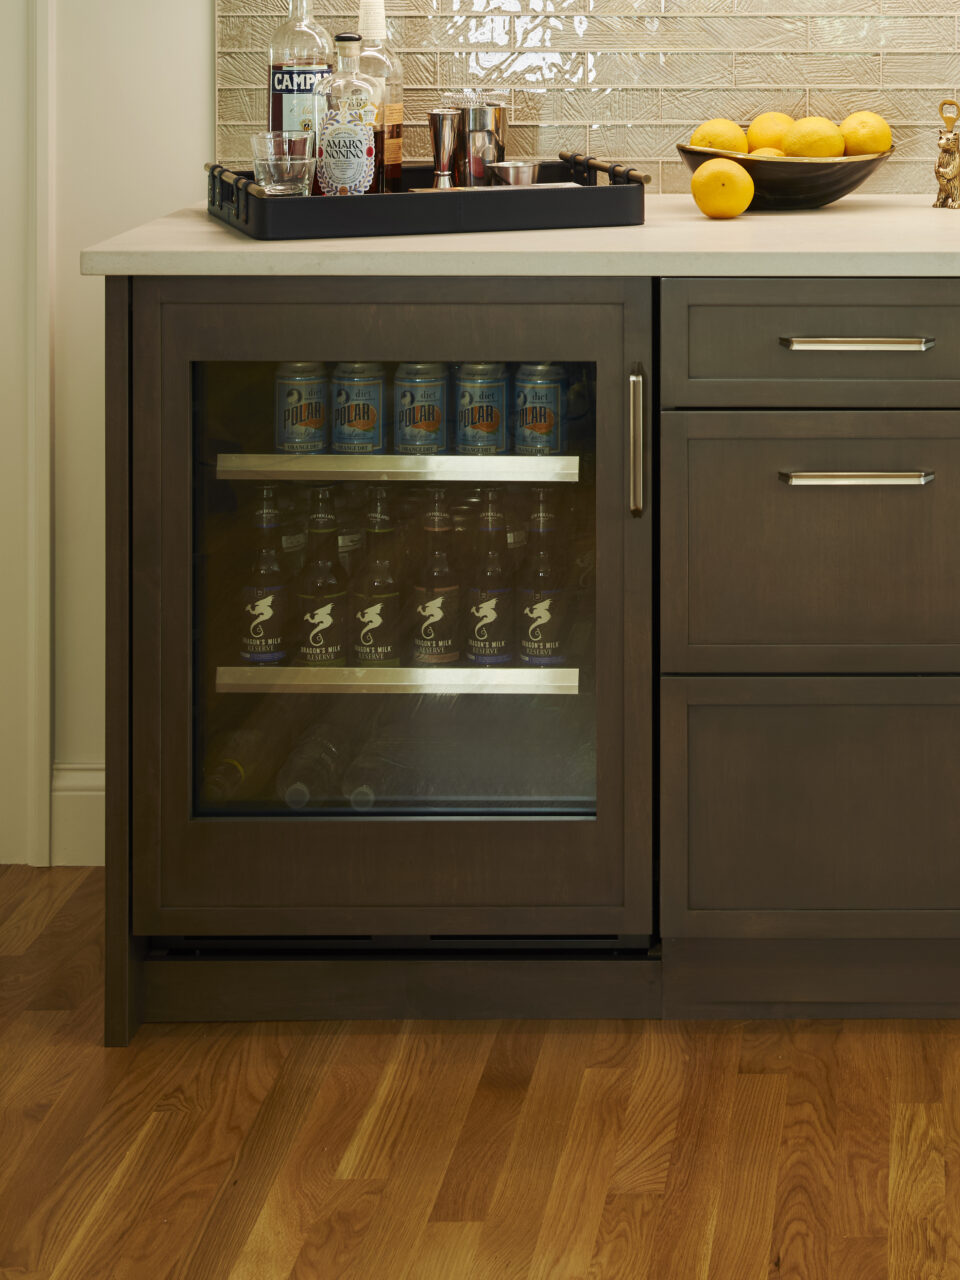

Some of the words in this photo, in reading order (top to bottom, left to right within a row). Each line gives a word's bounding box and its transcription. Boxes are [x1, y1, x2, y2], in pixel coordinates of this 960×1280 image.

[274, 73, 332, 91] CAMPA
[326, 139, 364, 150] AMARO
[325, 150, 365, 160] NONINO
[356, 389, 372, 399] diet
[420, 390, 437, 400] diet
[479, 391, 496, 401] diet
[532, 392, 549, 401] diet
[283, 401, 322, 432] POLAR
[334, 403, 370, 431] POLAR
[399, 404, 436, 432] POLAR
[458, 405, 494, 433] POLAR
[518, 406, 548, 429] OLAR
[267, 638, 281, 646] MILK
[438, 639, 452, 648] MILK
[491, 640, 505, 648] MILK
[545, 641, 559, 650] MILK
[377, 646, 392, 654] MILK
